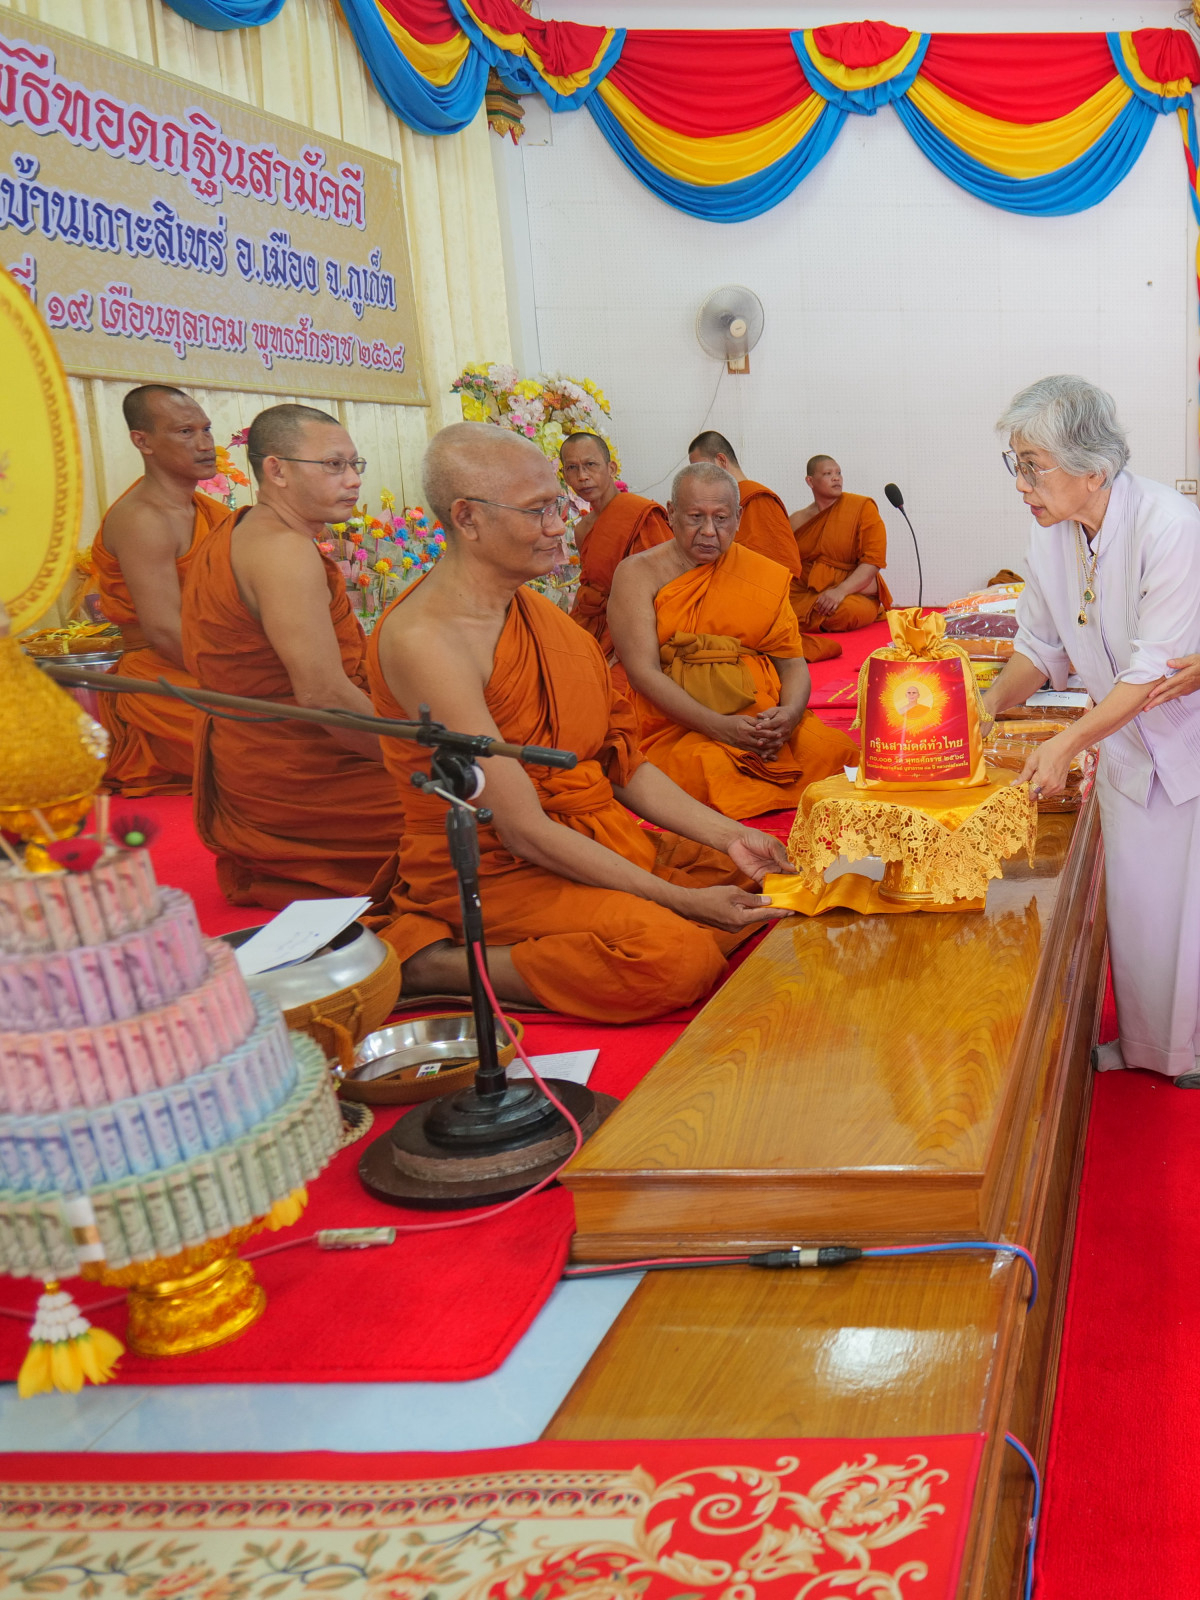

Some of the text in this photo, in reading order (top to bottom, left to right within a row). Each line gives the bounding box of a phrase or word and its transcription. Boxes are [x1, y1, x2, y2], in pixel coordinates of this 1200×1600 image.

[235, 231, 318, 290] อ.เมือง
[325, 249, 395, 316] จ.ภูเก็ต
[47, 286, 403, 369] ๑๙ เดือนตุลาคม พุทธศักราช ๒๕๖๘
[869, 736, 964, 753] กฐินสามัคคีทั่วไทย
